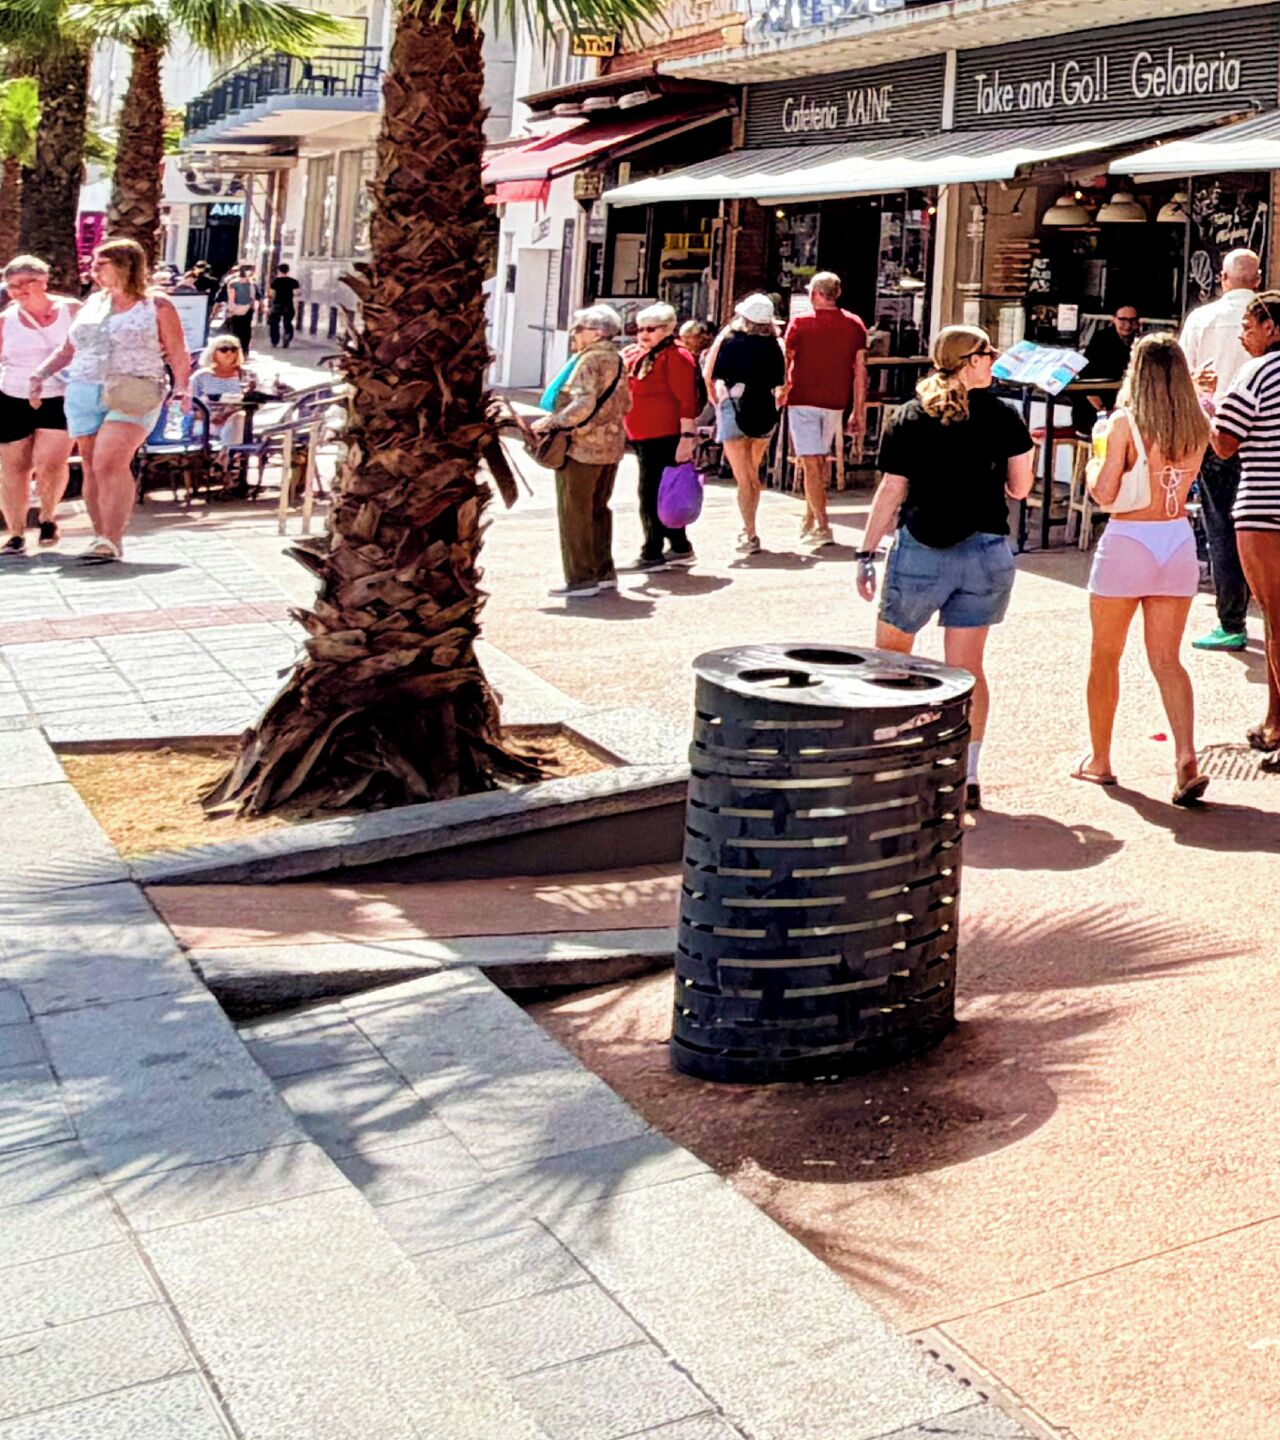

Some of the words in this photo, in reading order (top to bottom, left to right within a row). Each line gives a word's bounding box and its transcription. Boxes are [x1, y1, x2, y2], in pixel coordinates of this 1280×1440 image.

[782, 95, 838, 132] Cafeteria
[845, 85, 893, 126] XAINE
[974, 70, 1013, 114] Take
[1018, 62, 1055, 109] and
[1061, 56, 1108, 106] Go!!
[1132, 47, 1240, 98] Gelateria
